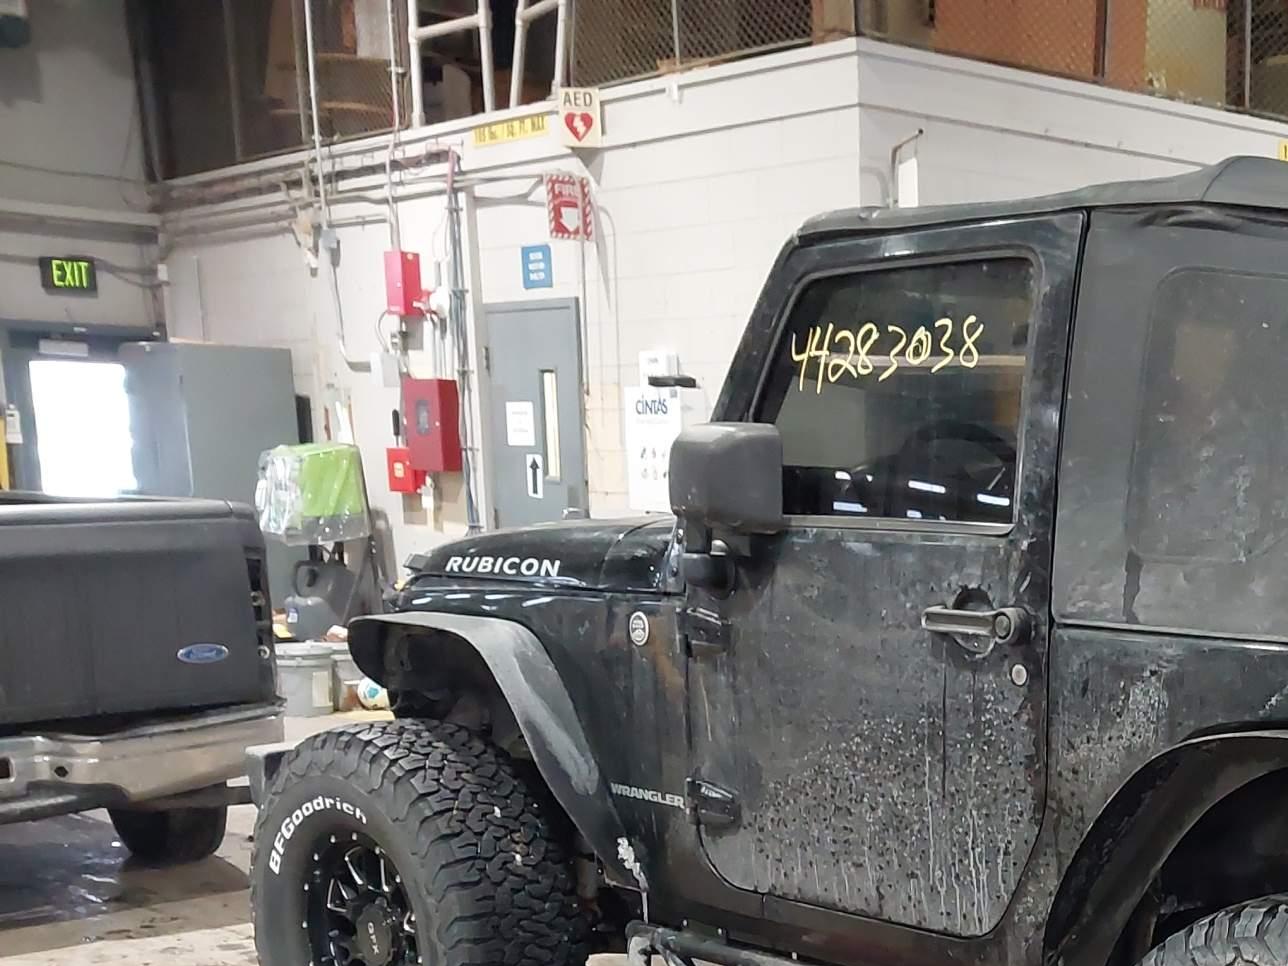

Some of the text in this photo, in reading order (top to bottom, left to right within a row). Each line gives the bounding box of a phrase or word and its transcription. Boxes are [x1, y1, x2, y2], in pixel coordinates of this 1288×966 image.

[563, 91, 593, 107] AED
[52, 259, 89, 288] EXIT
[791, 315, 984, 394] 44283038
[635, 394, 668, 415] CINTAS
[445, 556, 561, 577] RUBICON
[610, 782, 685, 809] WRANGLER
[269, 796, 367, 876] BFGoodrich
